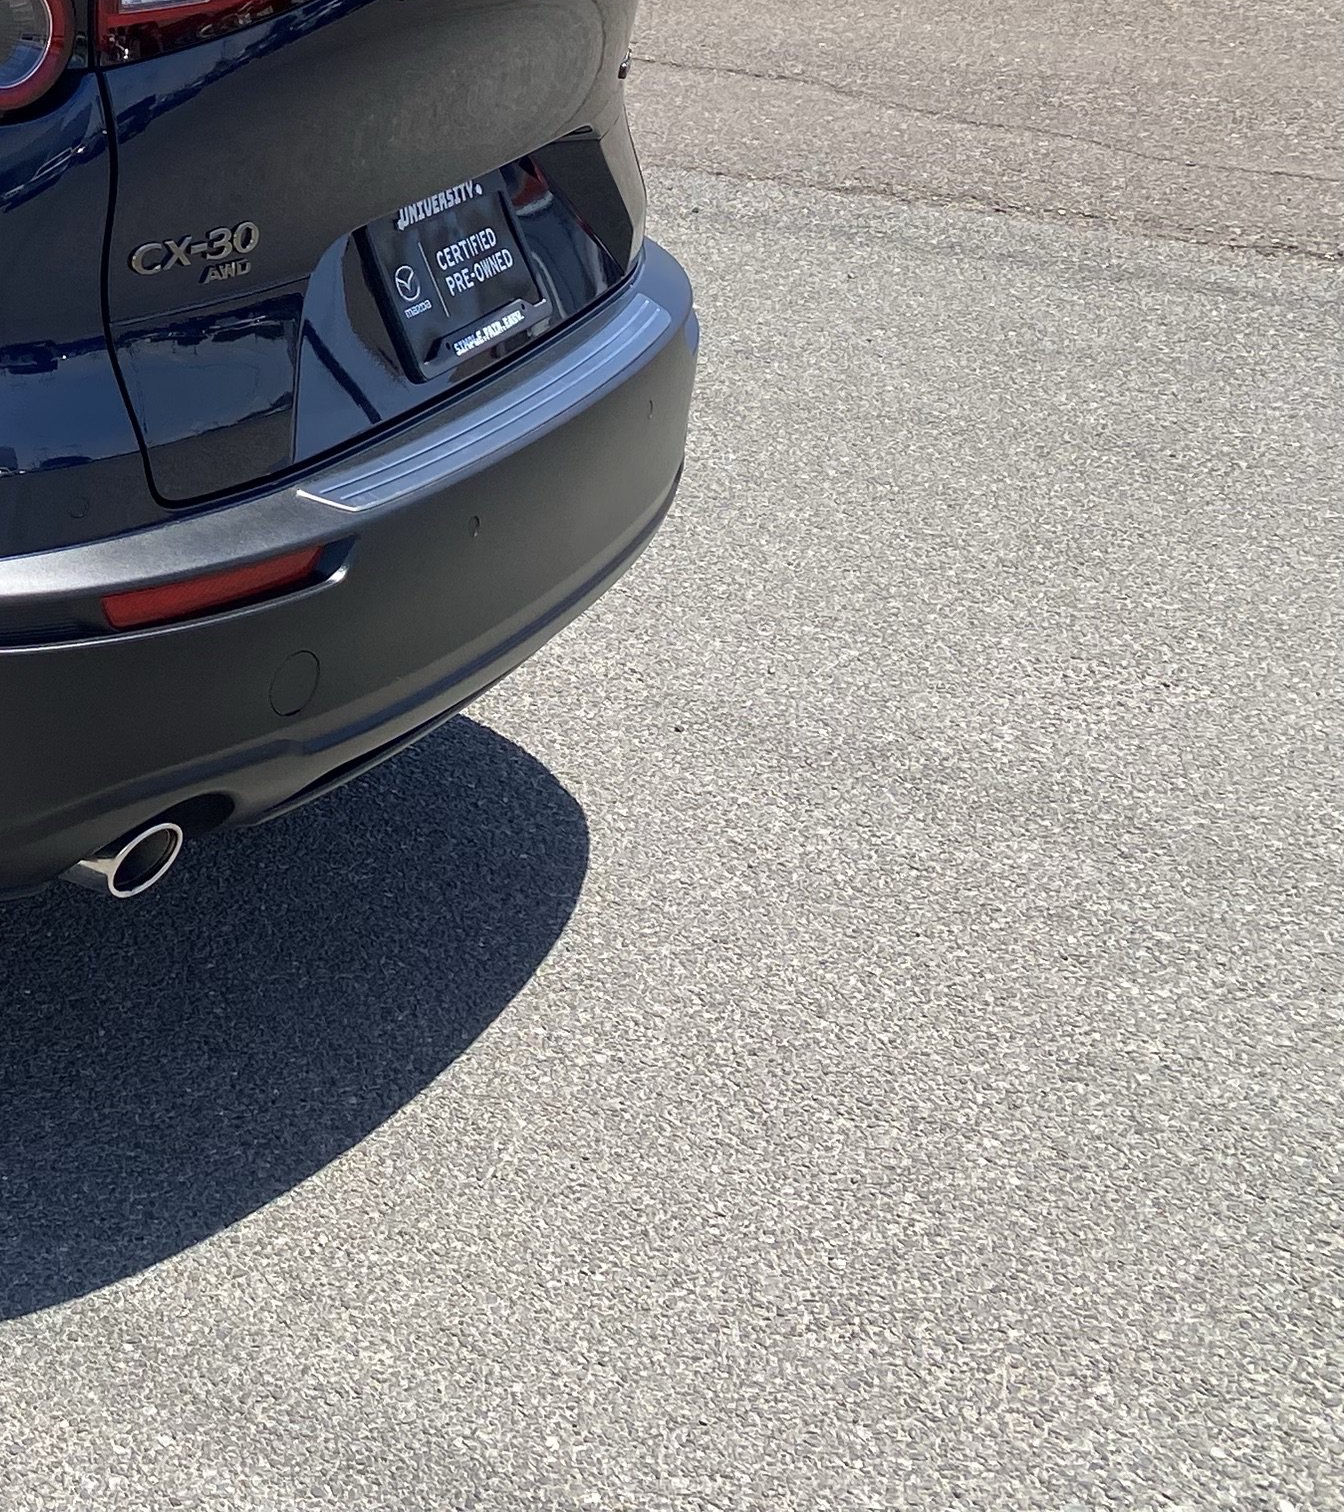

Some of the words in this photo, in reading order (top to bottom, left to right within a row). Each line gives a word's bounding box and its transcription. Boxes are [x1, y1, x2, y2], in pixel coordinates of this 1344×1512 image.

[399, 179, 474, 227] UNIVERSITY
[130, 220, 260, 276] CX-30
[201, 258, 252, 285] AWD
[436, 227, 497, 271] CERTIFIED
[445, 248, 514, 297] PRE-OWNED
